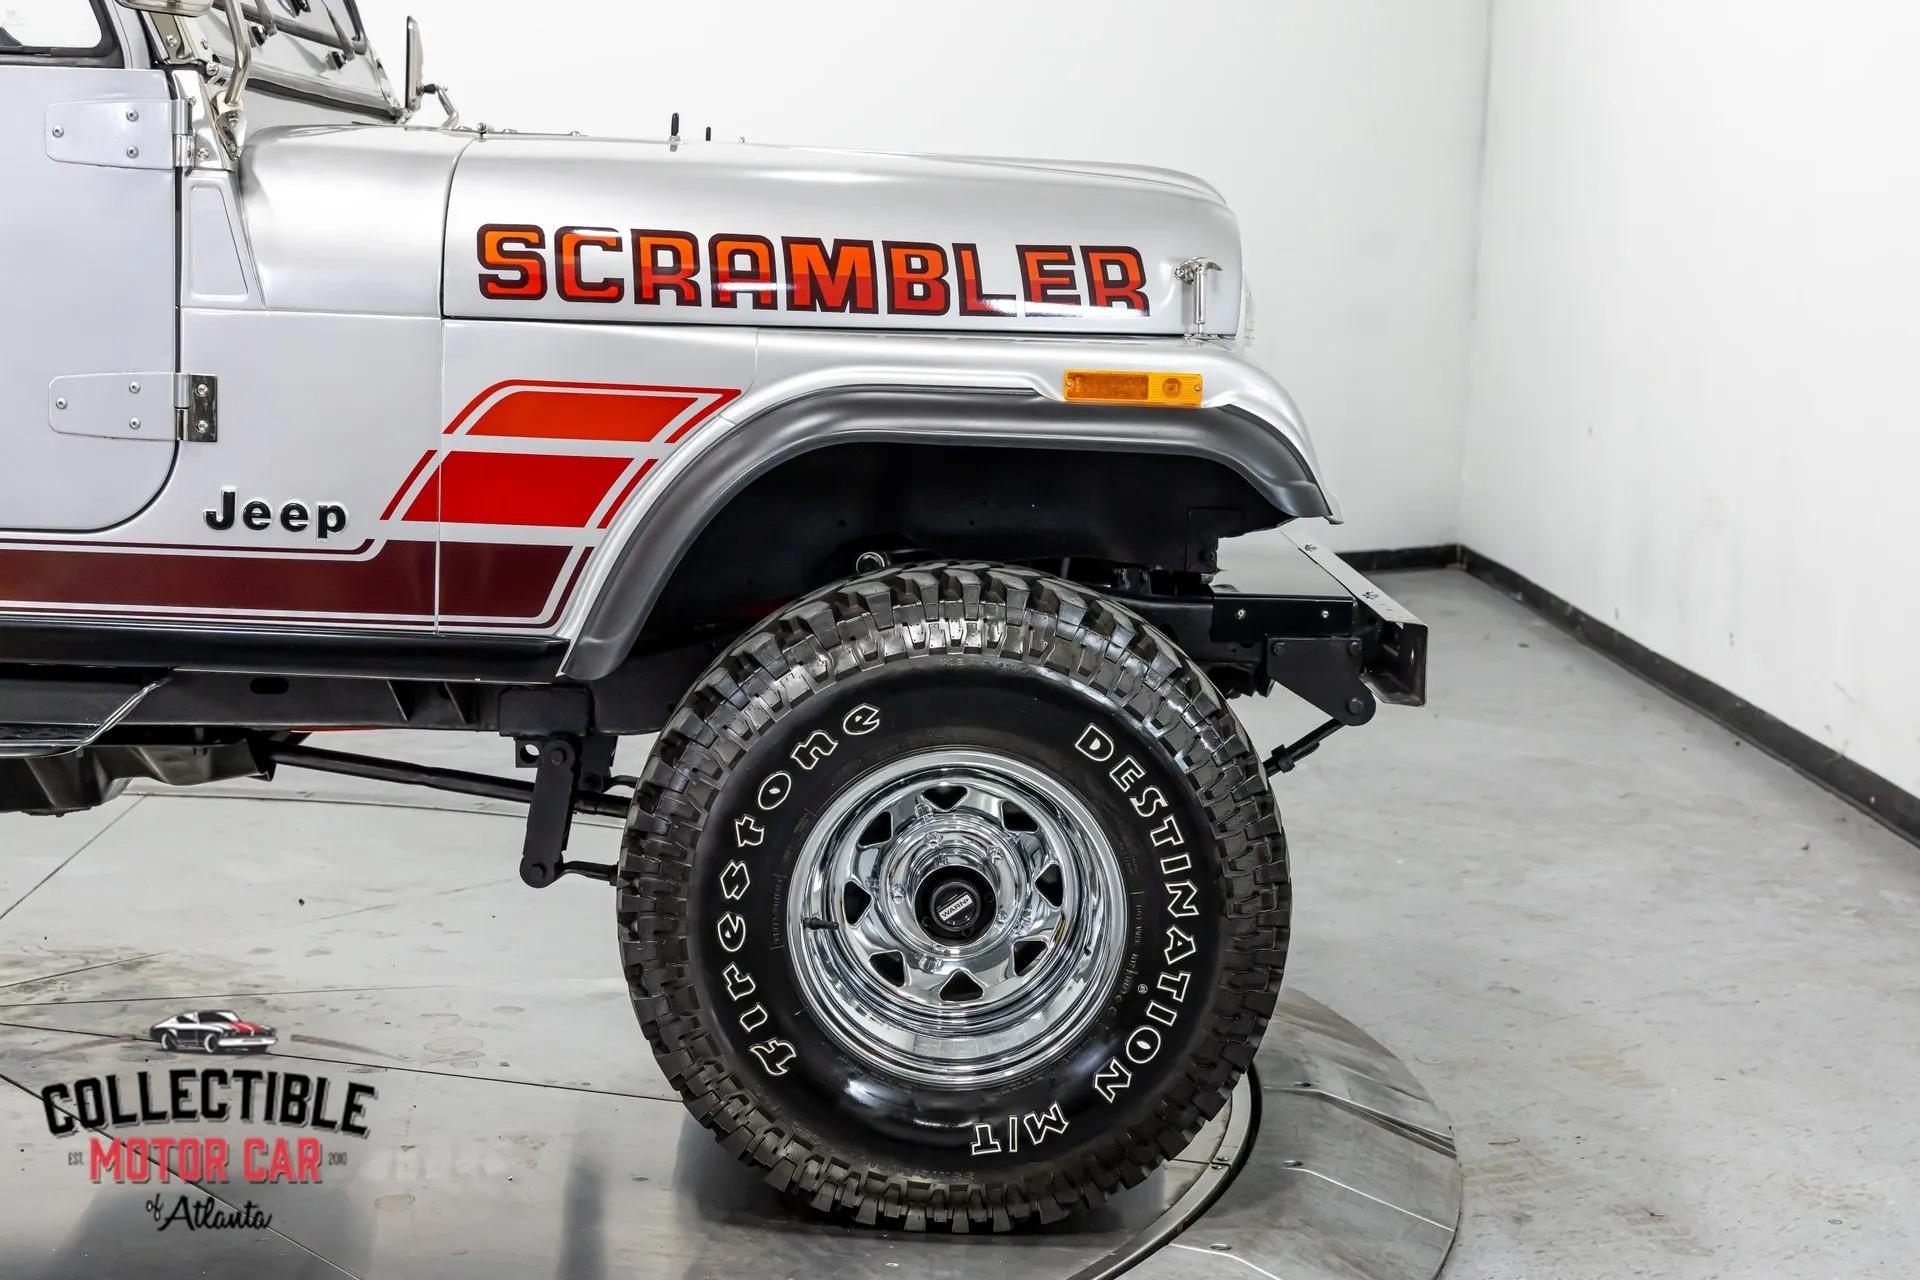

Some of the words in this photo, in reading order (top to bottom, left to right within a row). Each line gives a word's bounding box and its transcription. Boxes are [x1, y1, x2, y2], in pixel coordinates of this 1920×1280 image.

[477, 223, 1151, 317] SCRAMBLER
[203, 486, 349, 541] Jeep
[717, 703, 881, 1076] Firestone
[941, 898, 969, 918] WARN
[1074, 723, 1200, 1103] DESTINATION
[970, 1103, 1069, 1156] M/T
